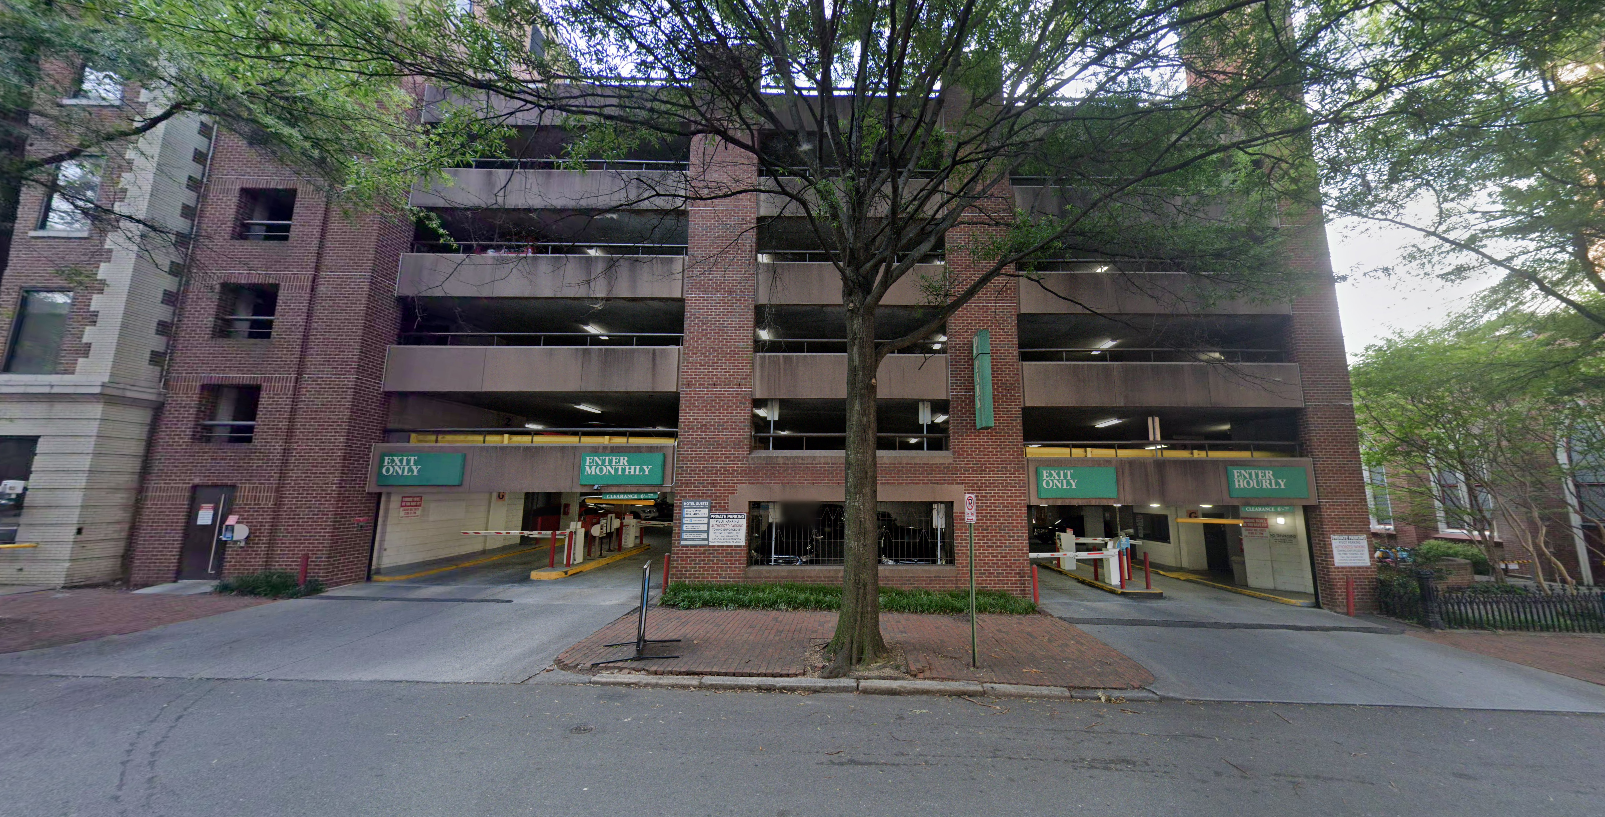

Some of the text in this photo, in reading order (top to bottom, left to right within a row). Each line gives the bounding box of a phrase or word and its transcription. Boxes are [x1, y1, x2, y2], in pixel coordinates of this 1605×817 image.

[382, 456, 418, 466] EXIT
[585, 456, 628, 466] ENTER
[382, 465, 422, 476] ONLY
[584, 466, 652, 475] MONTHLY
[1042, 470, 1074, 480] EXIT
[1233, 470, 1274, 479] ENTER
[1042, 480, 1078, 489] ONLY
[1234, 479, 1286, 488] HOURLY
